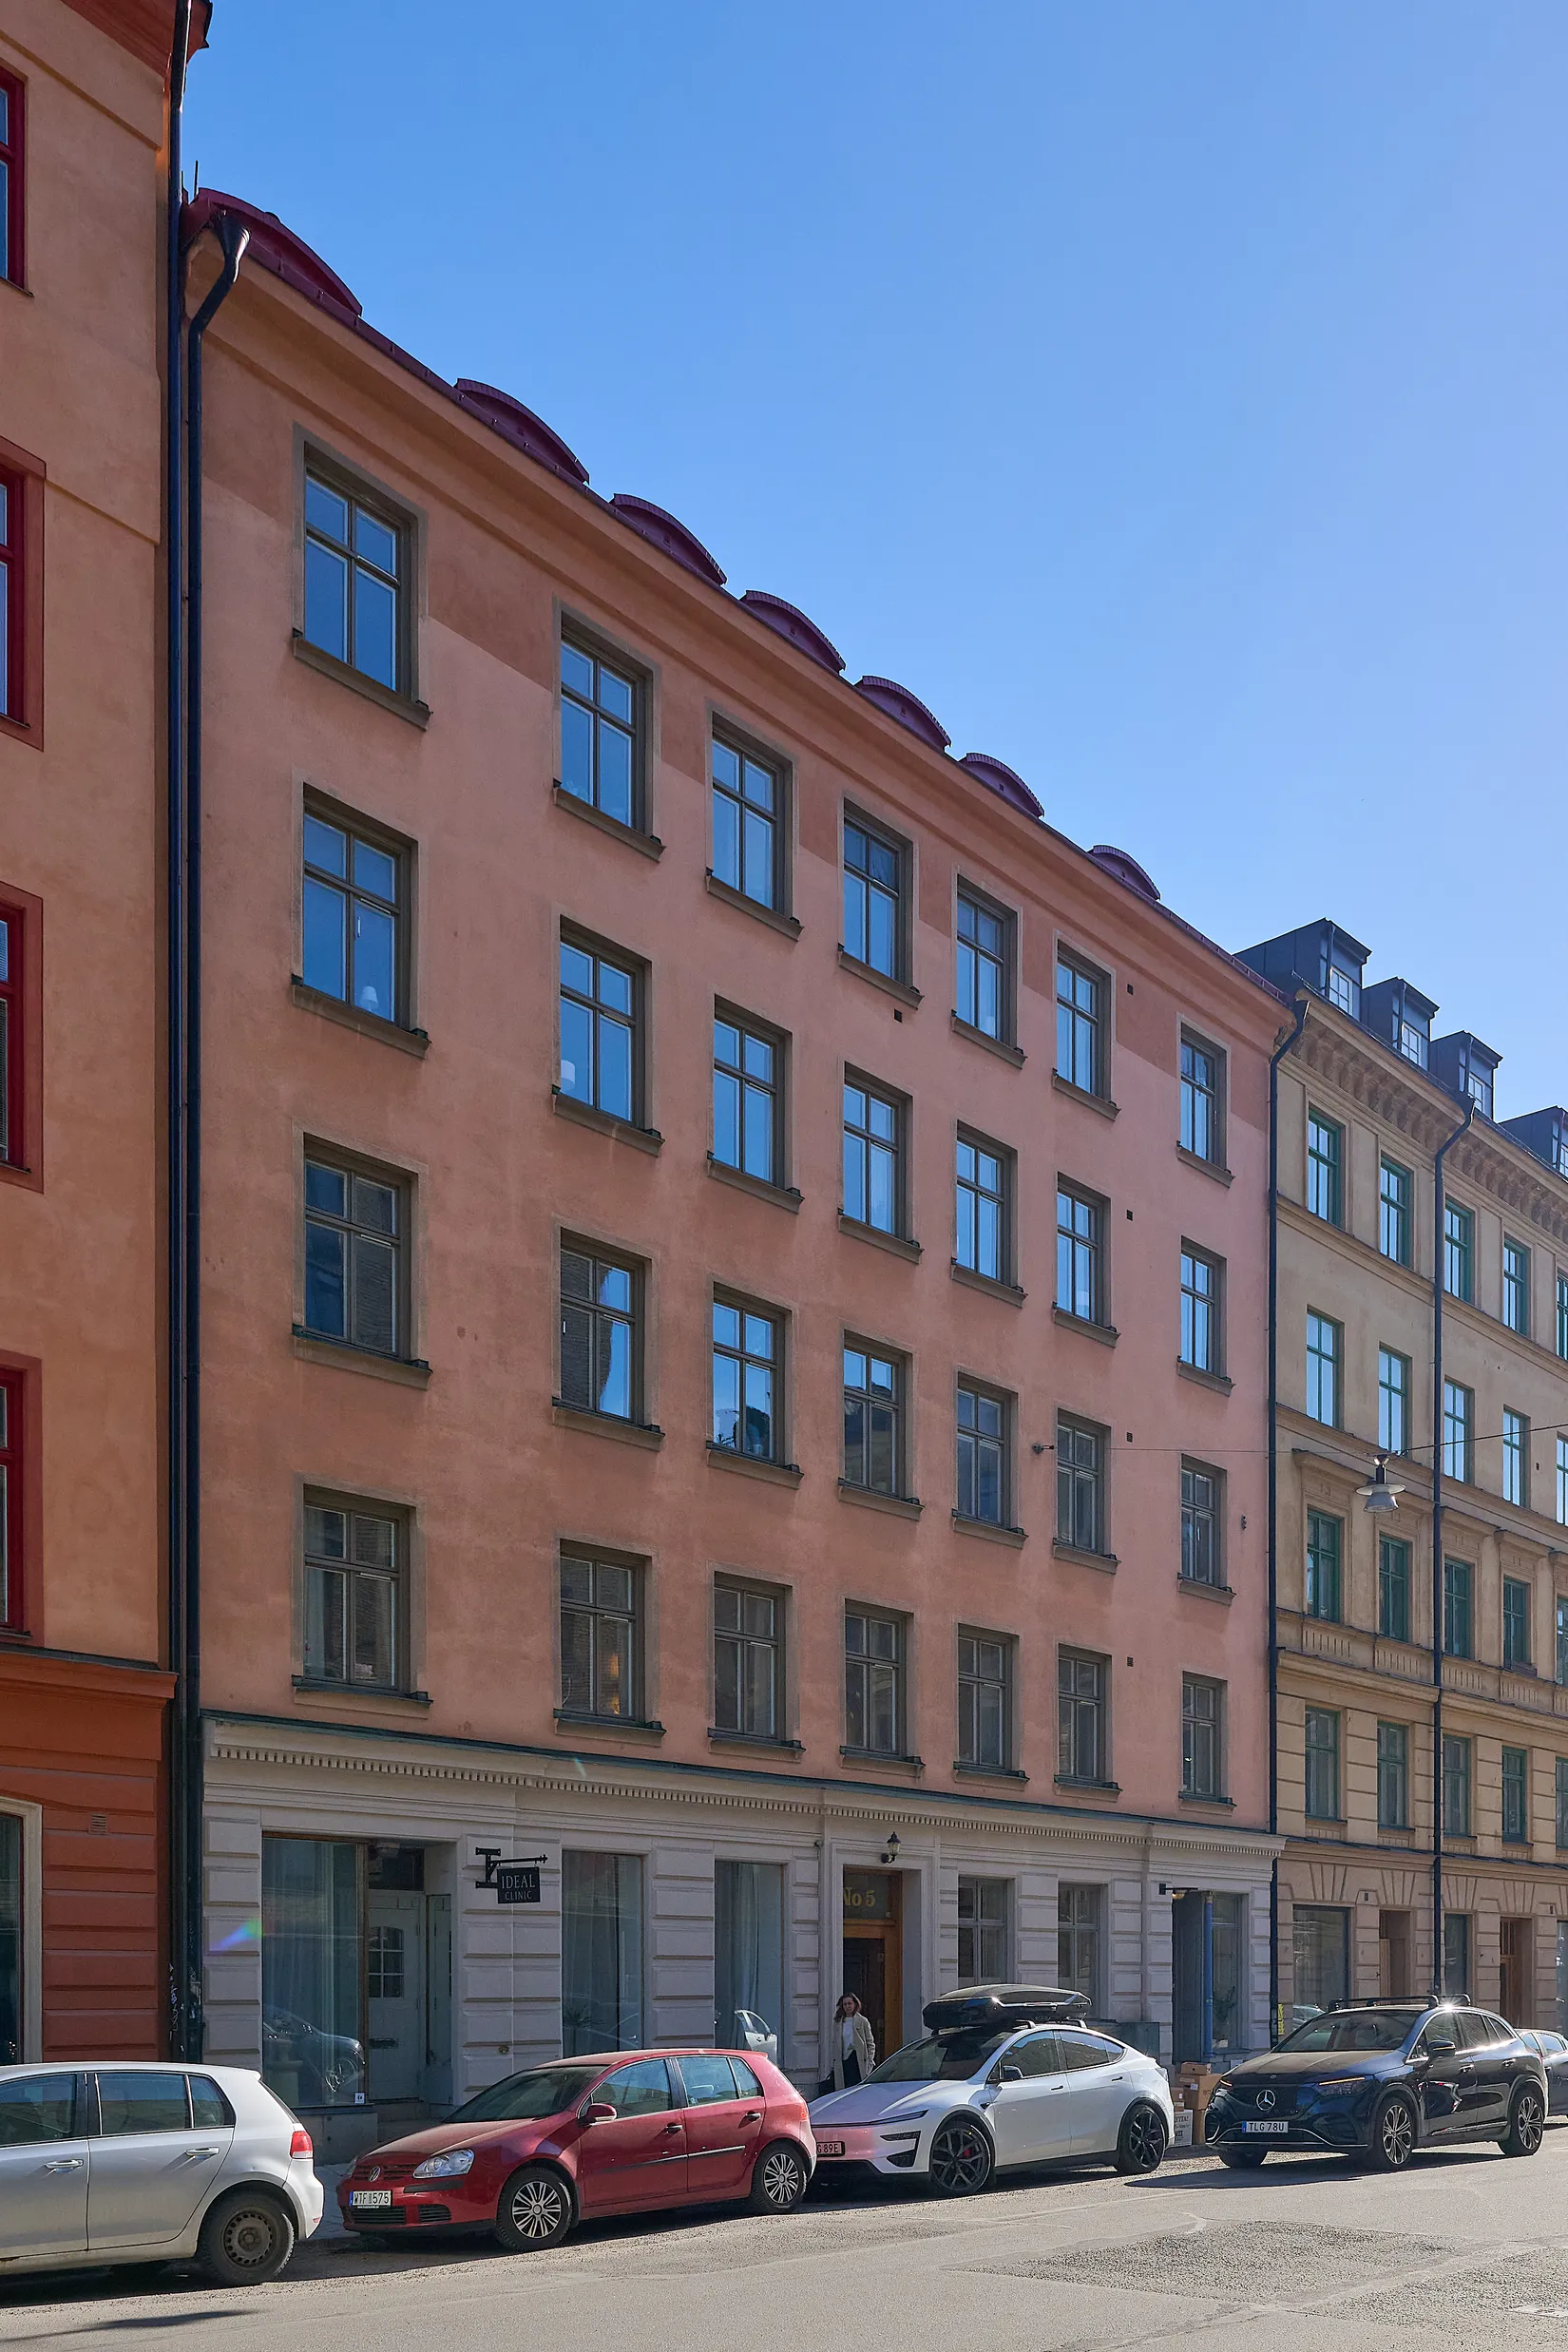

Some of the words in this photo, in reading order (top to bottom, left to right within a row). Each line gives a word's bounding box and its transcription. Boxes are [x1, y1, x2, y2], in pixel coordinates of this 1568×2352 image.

[502, 1874, 536, 1889] IDEAL
[505, 1890, 533, 1901] CLINIC
[866, 1889, 875, 1907] 5
[1249, 2122, 1265, 2132] TLG
[1267, 2122, 1285, 2132] 78U
[823, 2143, 838, 2153] 89E
[373, 2192, 390, 2205] 575
